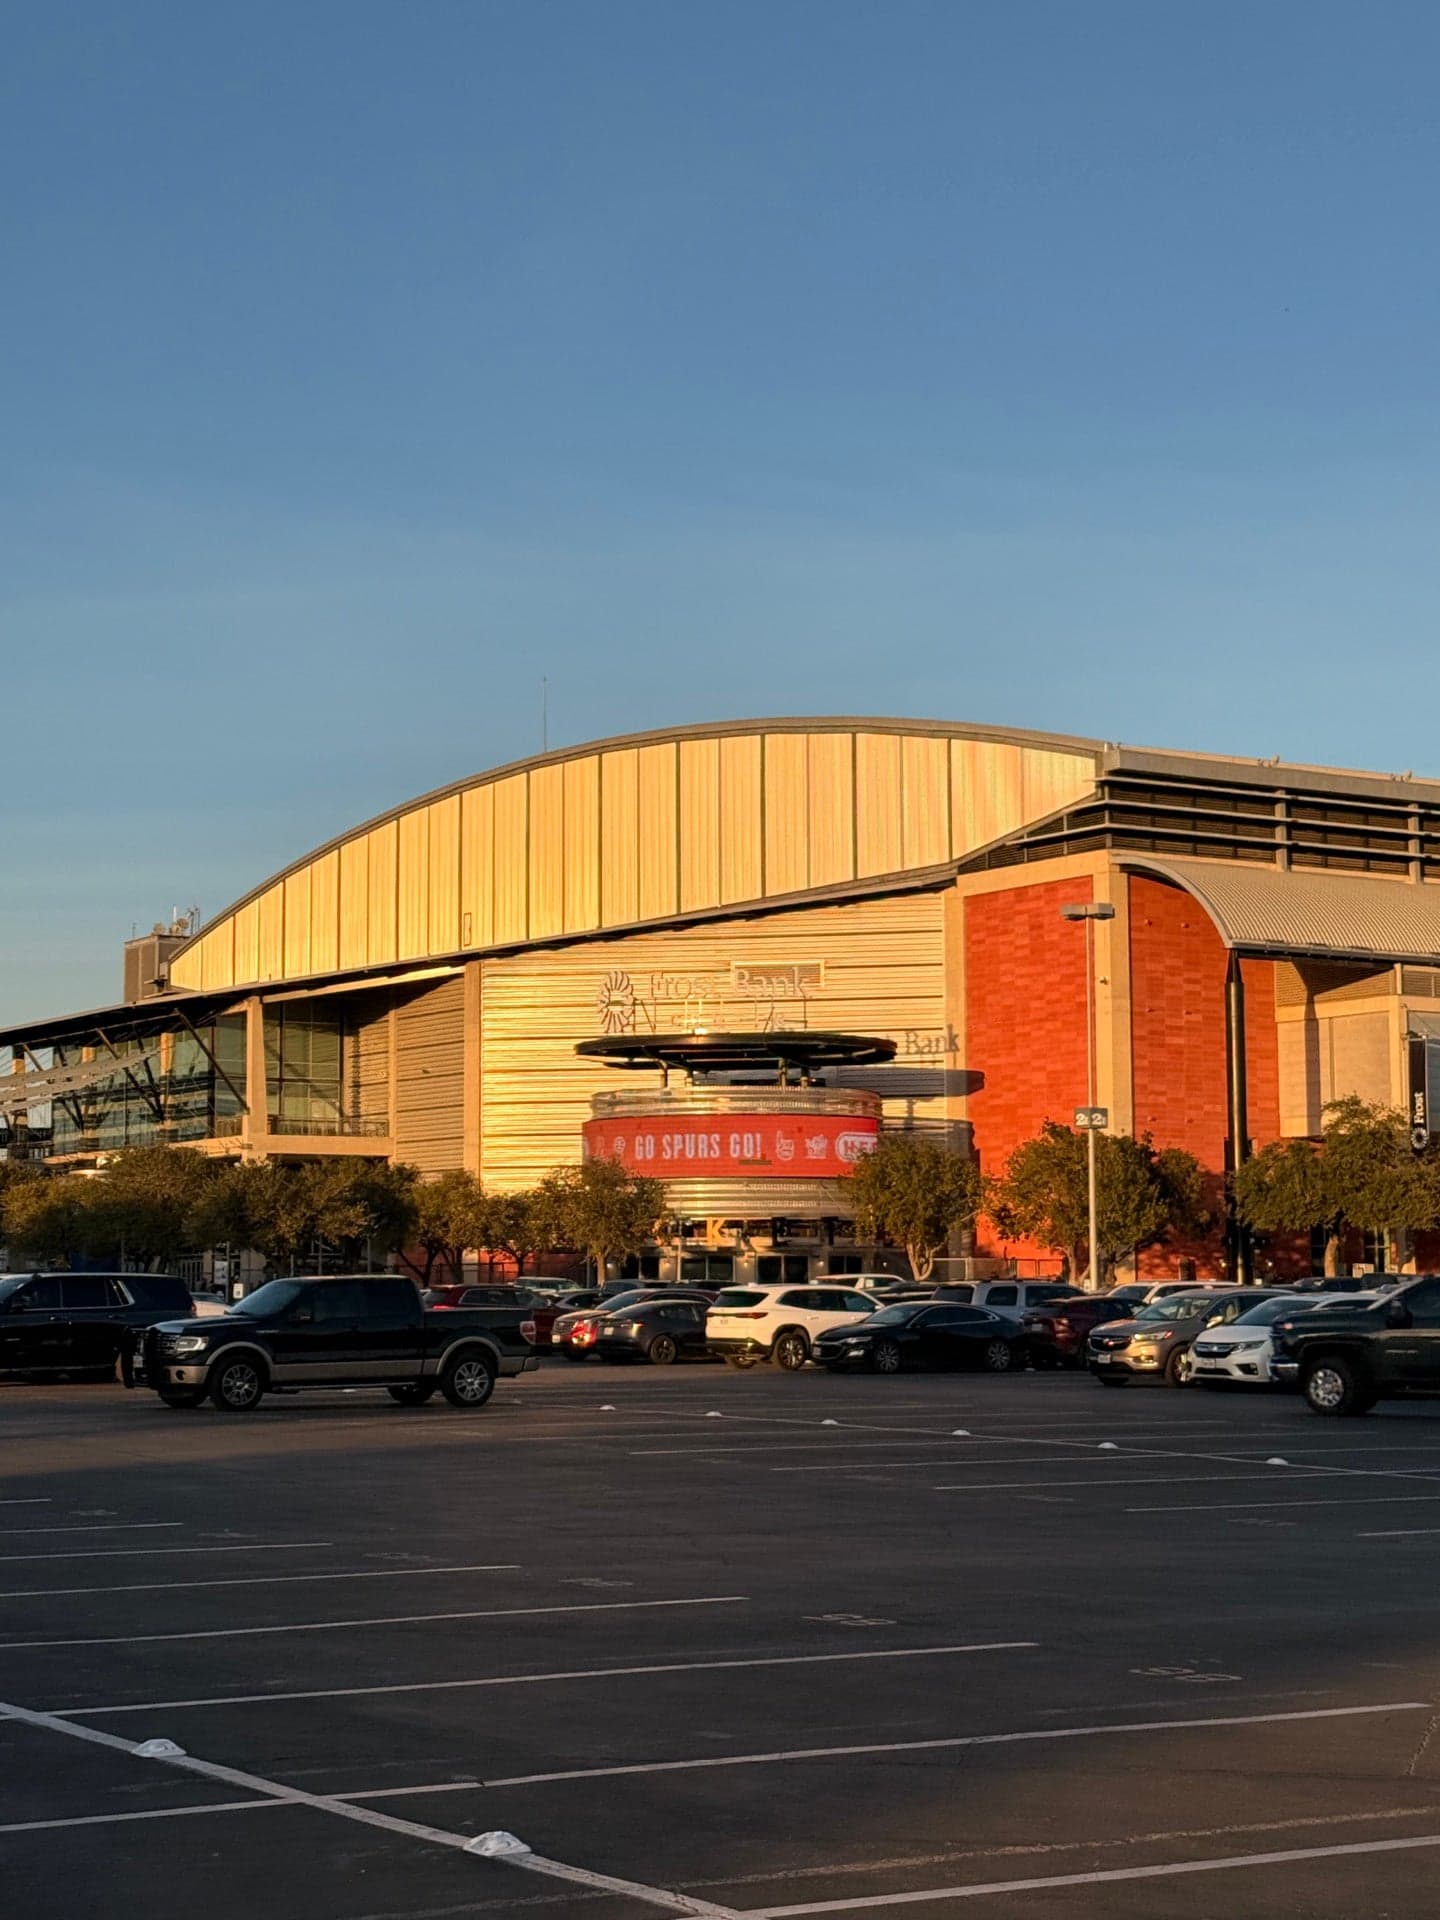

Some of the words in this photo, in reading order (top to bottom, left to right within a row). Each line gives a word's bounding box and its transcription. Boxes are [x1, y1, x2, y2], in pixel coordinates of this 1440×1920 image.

[649, 970, 718, 999] Fros
[733, 966, 812, 998] Bank
[1413, 1091, 1425, 1124] Frost
[635, 1134, 655, 1161] GO
[662, 1132, 721, 1160] SPURS
[729, 1132, 762, 1160] GO!
